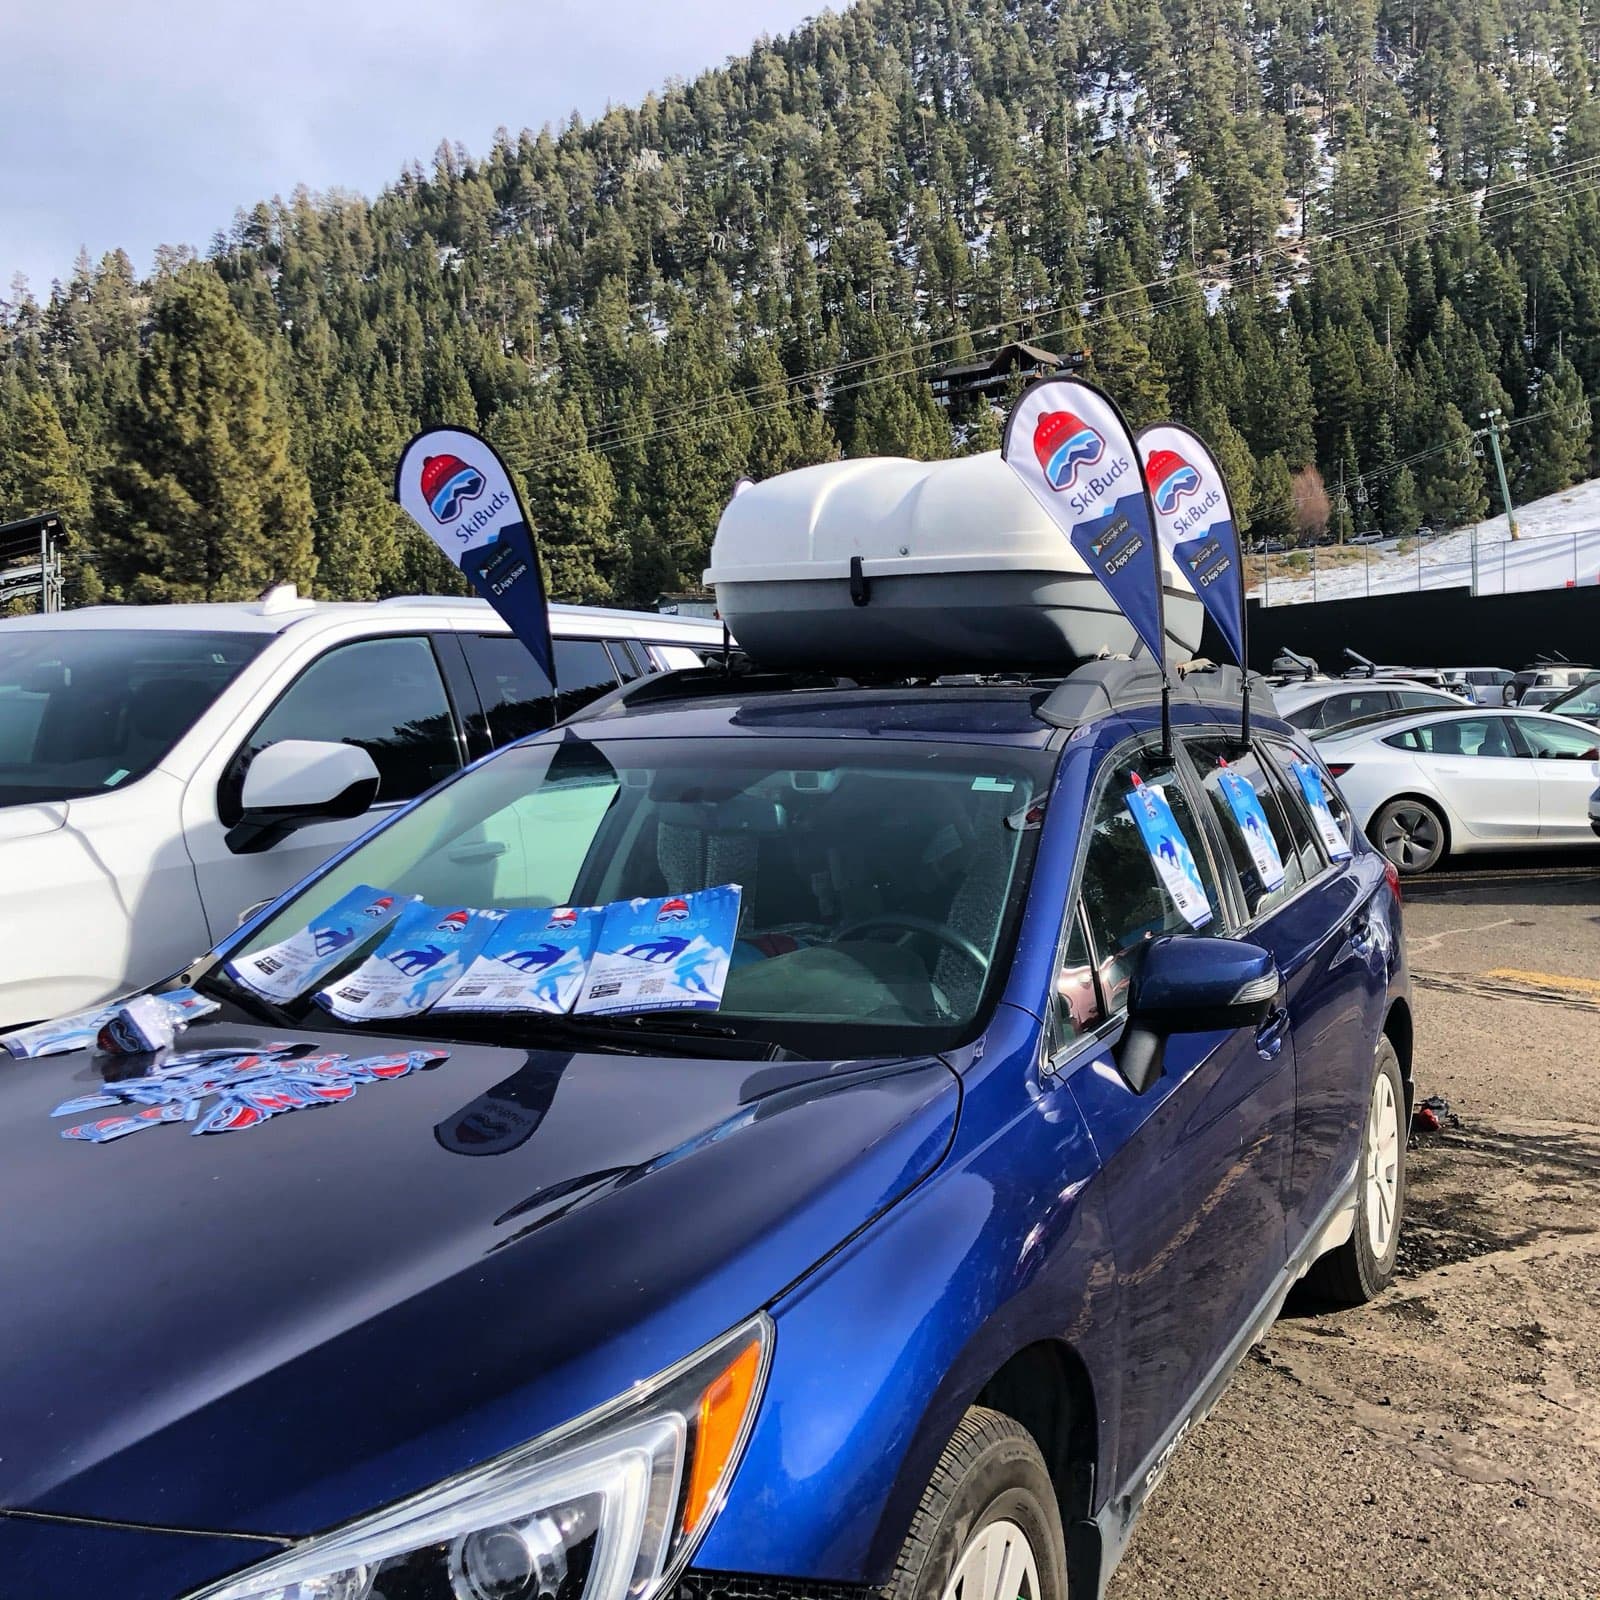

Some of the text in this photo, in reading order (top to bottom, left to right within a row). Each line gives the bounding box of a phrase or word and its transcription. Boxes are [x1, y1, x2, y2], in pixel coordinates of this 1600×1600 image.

[1069, 457, 1129, 515] SkiBuds
[456, 491, 510, 544] SkiBuds
[1173, 490, 1221, 536] SkiBuds
[500, 564, 527, 590] App Store
[1114, 553, 1129, 569] App
[1126, 540, 1143, 558] Store
